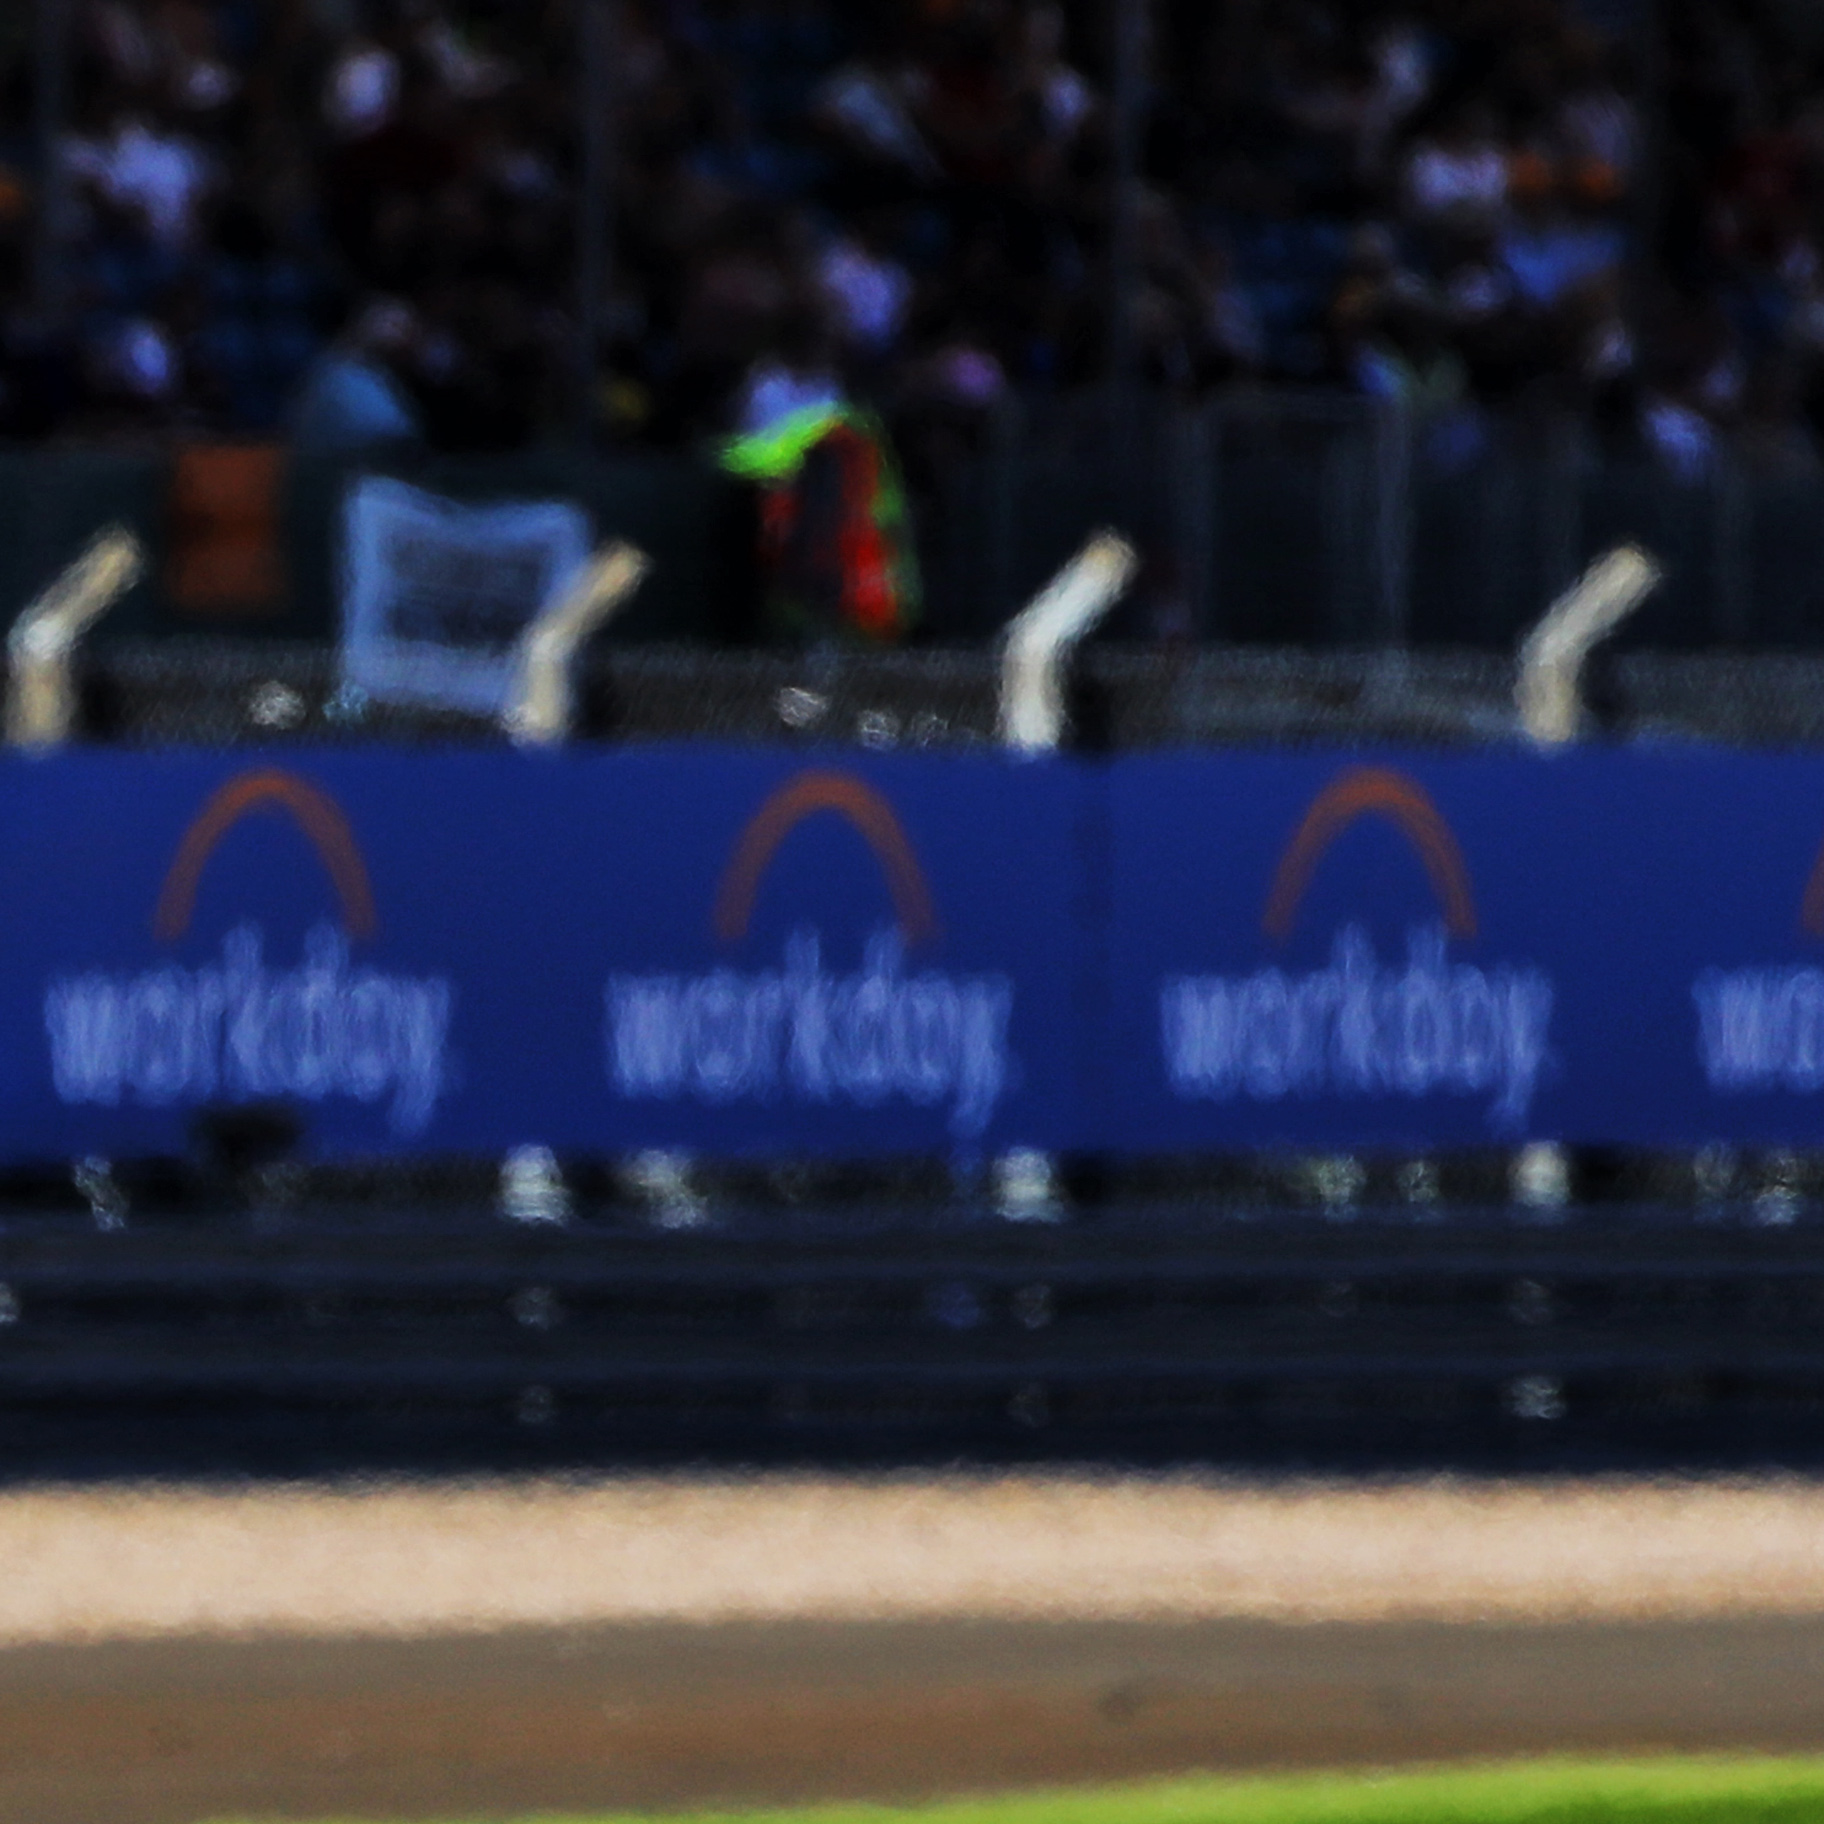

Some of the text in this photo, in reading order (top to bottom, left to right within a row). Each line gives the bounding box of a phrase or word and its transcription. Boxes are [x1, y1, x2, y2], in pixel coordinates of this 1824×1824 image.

[43, 926, 450, 1130] workday
[608, 931, 1012, 1131] workday
[1160, 929, 1551, 1130] workday
